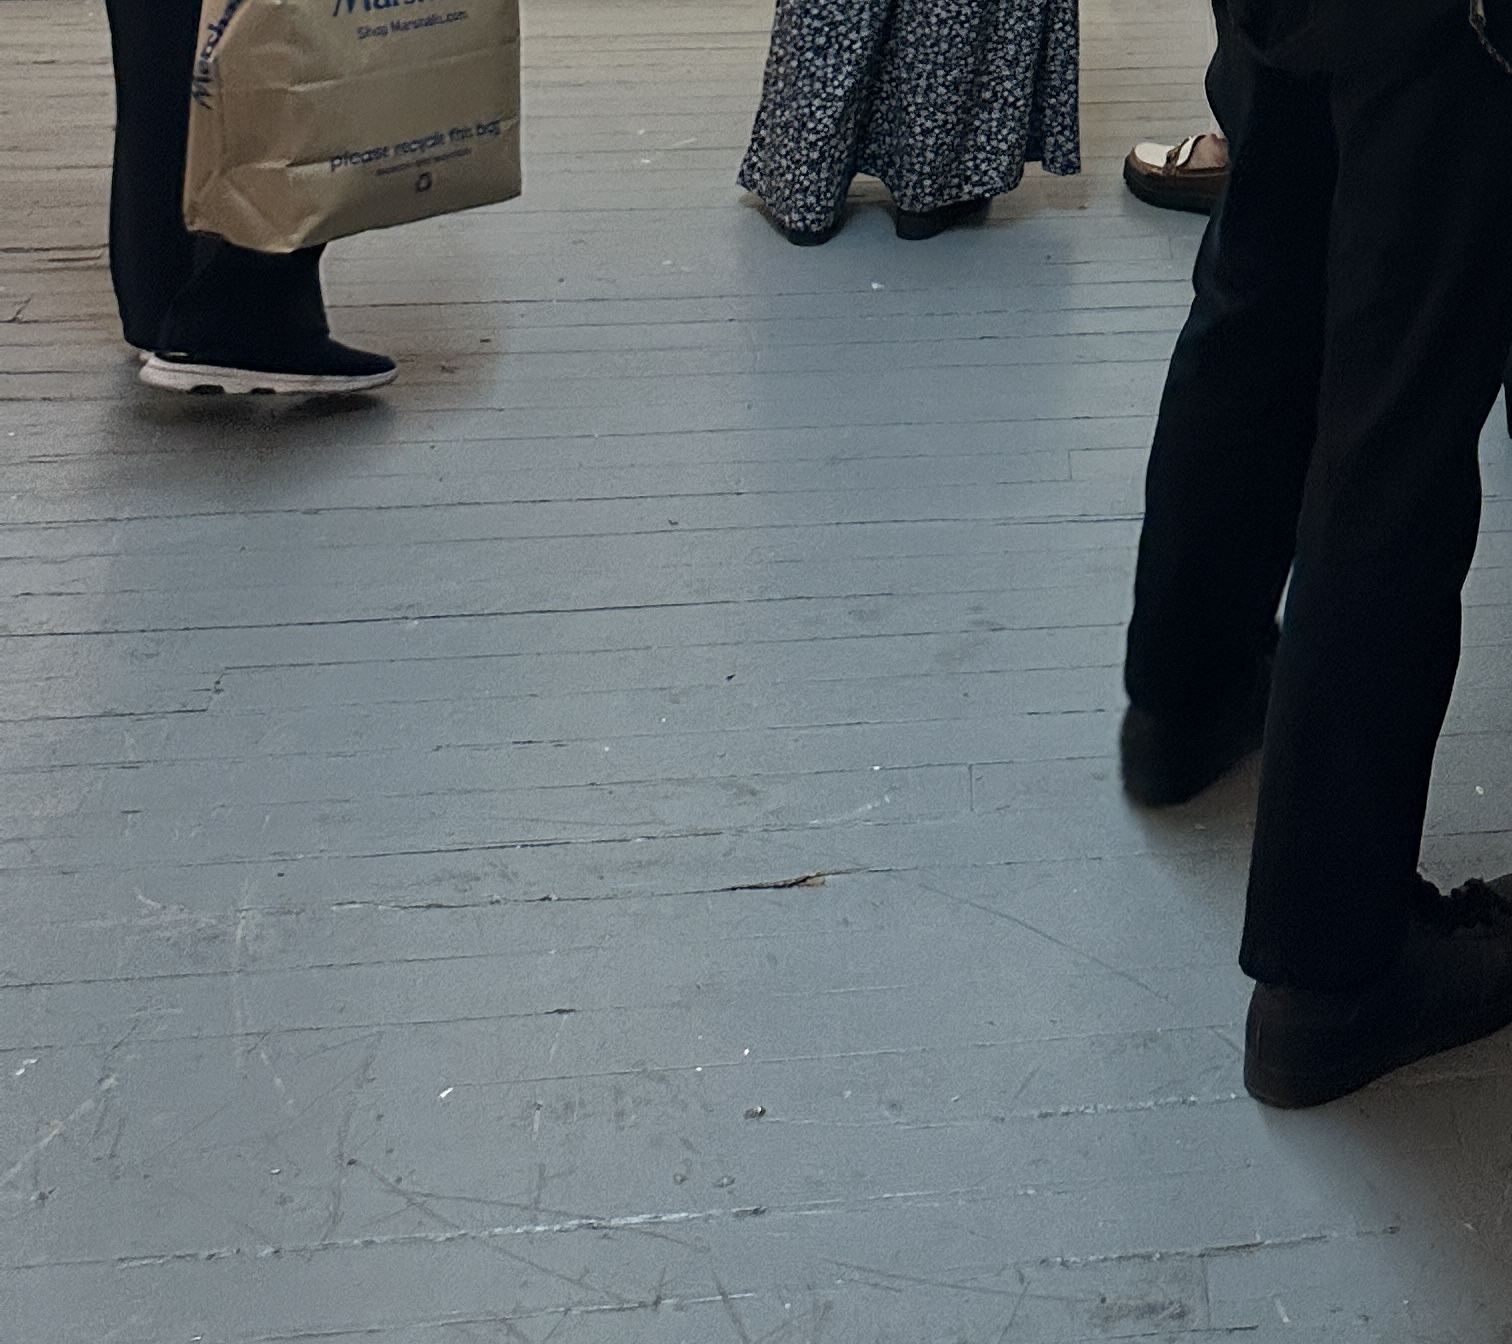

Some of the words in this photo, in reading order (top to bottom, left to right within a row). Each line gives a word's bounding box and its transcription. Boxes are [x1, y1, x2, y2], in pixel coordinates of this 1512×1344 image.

[330, 146, 389, 172] please
[394, 132, 446, 155] recycle
[448, 126, 474, 142] this
